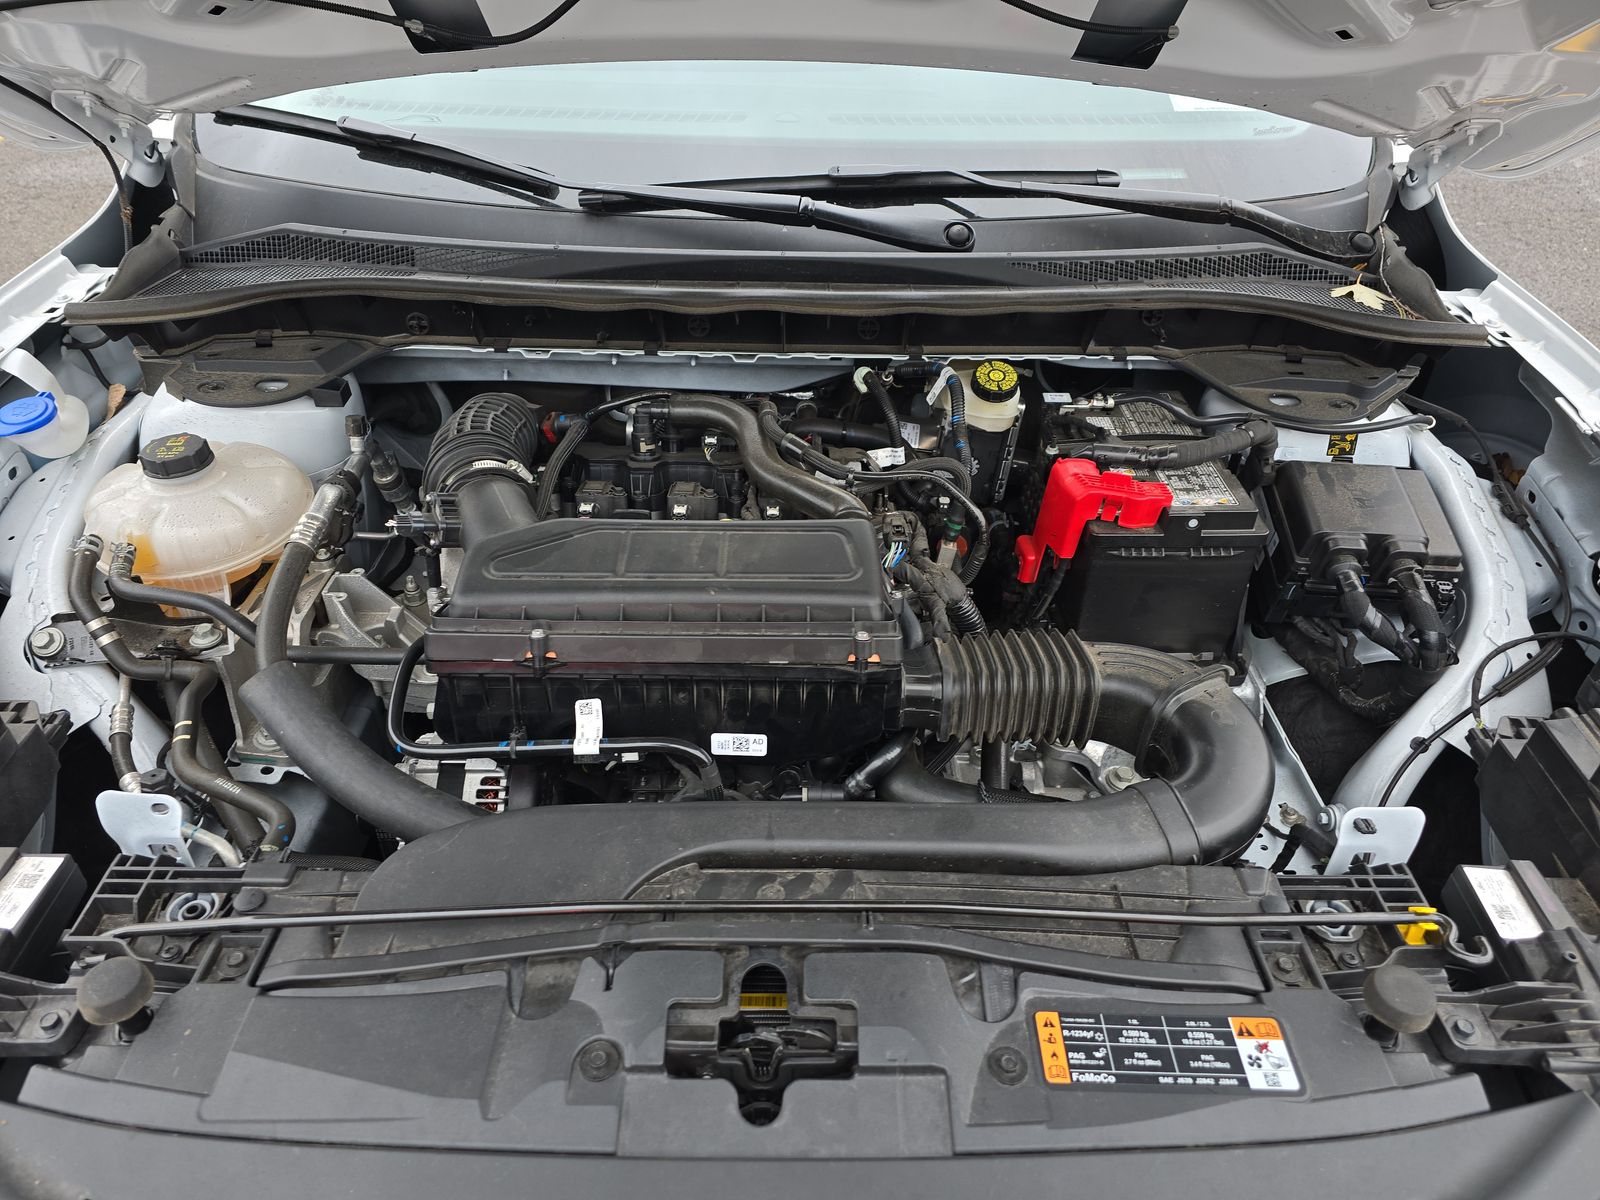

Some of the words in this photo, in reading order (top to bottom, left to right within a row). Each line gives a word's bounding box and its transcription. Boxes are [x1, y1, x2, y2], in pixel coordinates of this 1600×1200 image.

[1062, 1029, 1094, 1039] R-1234yf
[1068, 1051, 1086, 1060] PAG
[1133, 1051, 1149, 1059] PAG
[1071, 1072, 1116, 1083] FoMoCo
[1158, 1076, 1175, 1084] SAE
